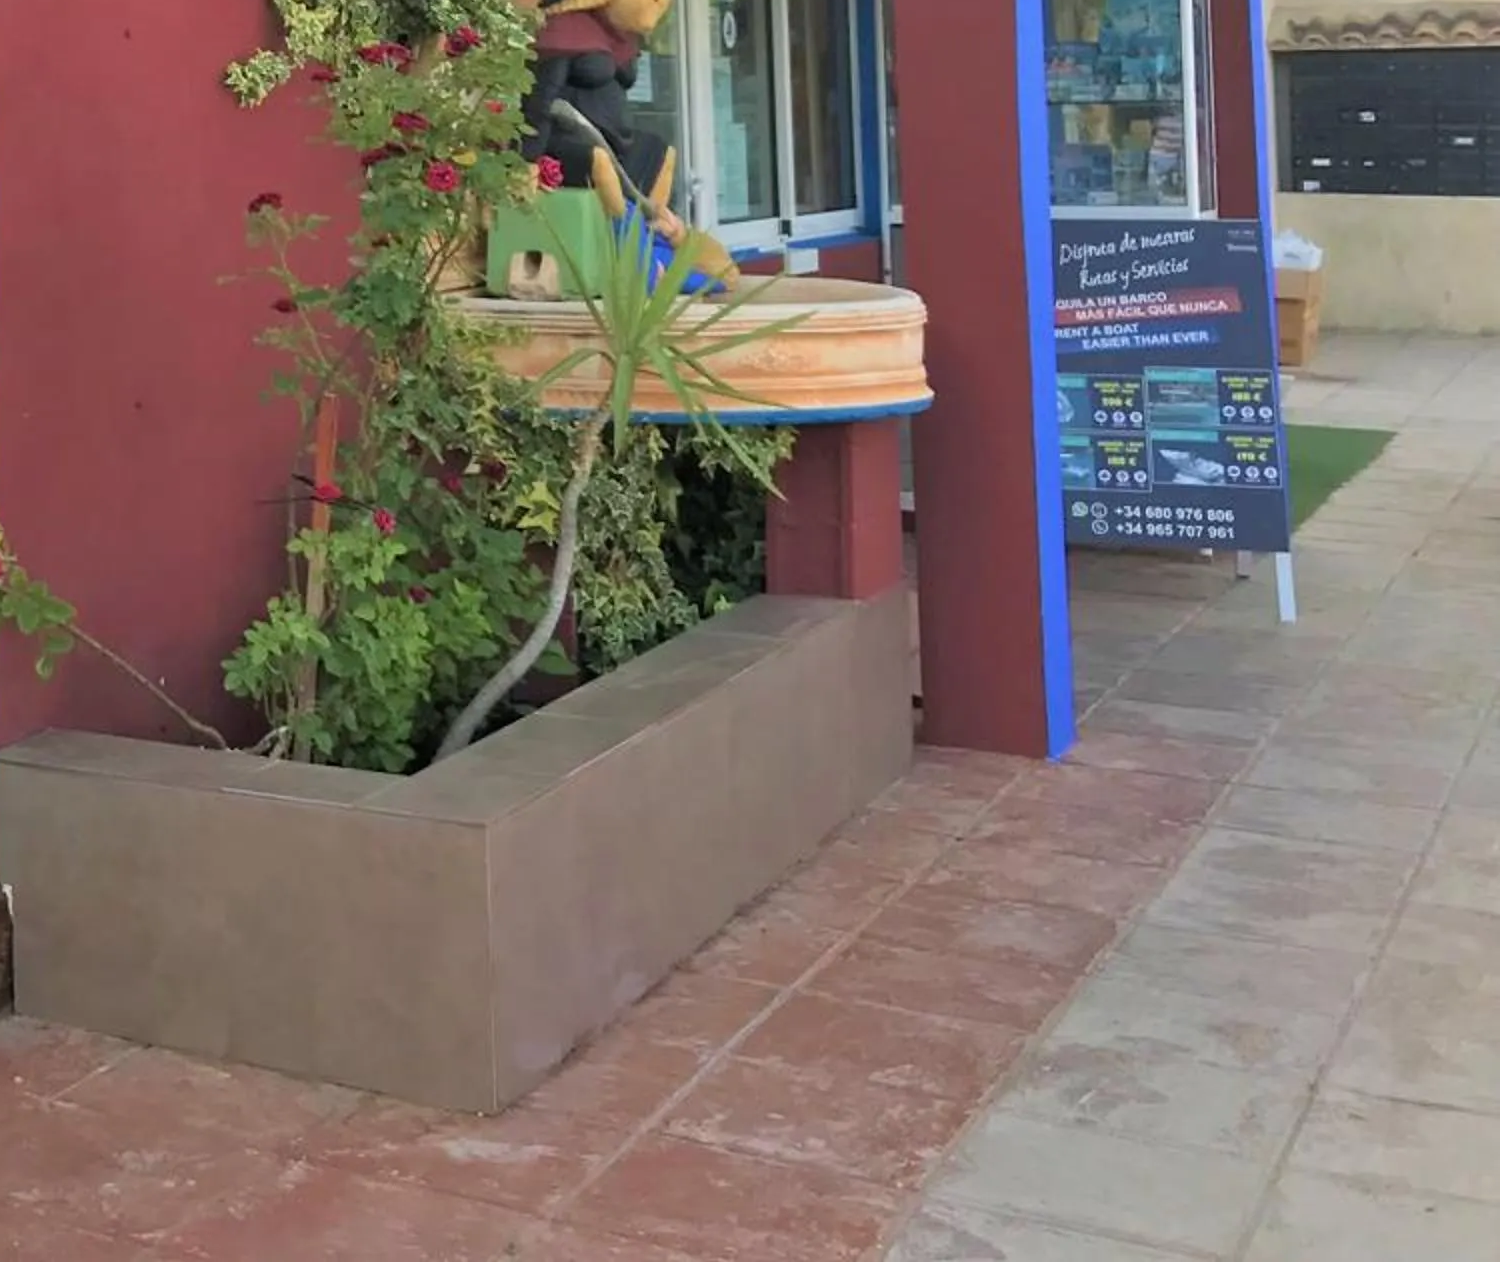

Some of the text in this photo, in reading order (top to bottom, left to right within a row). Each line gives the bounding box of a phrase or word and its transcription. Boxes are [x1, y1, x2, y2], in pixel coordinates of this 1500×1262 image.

[1119, 231, 1138, 253] de
[1079, 256, 1189, 290] Rutas y Servicios
[1056, 291, 1167, 310] QUILA UN BARCO
[1148, 303, 1176, 317] QUE
[1179, 299, 1229, 315] NUNCA
[1054, 322, 1140, 339] RENT A BOAT
[1082, 330, 1210, 351] EASIER THAN EVER
[1114, 505, 1141, 518] +34
[1175, 506, 1203, 521] 976
[1116, 521, 1143, 535] +34
[1145, 522, 1173, 536] 965
[1176, 523, 1204, 537] 707
